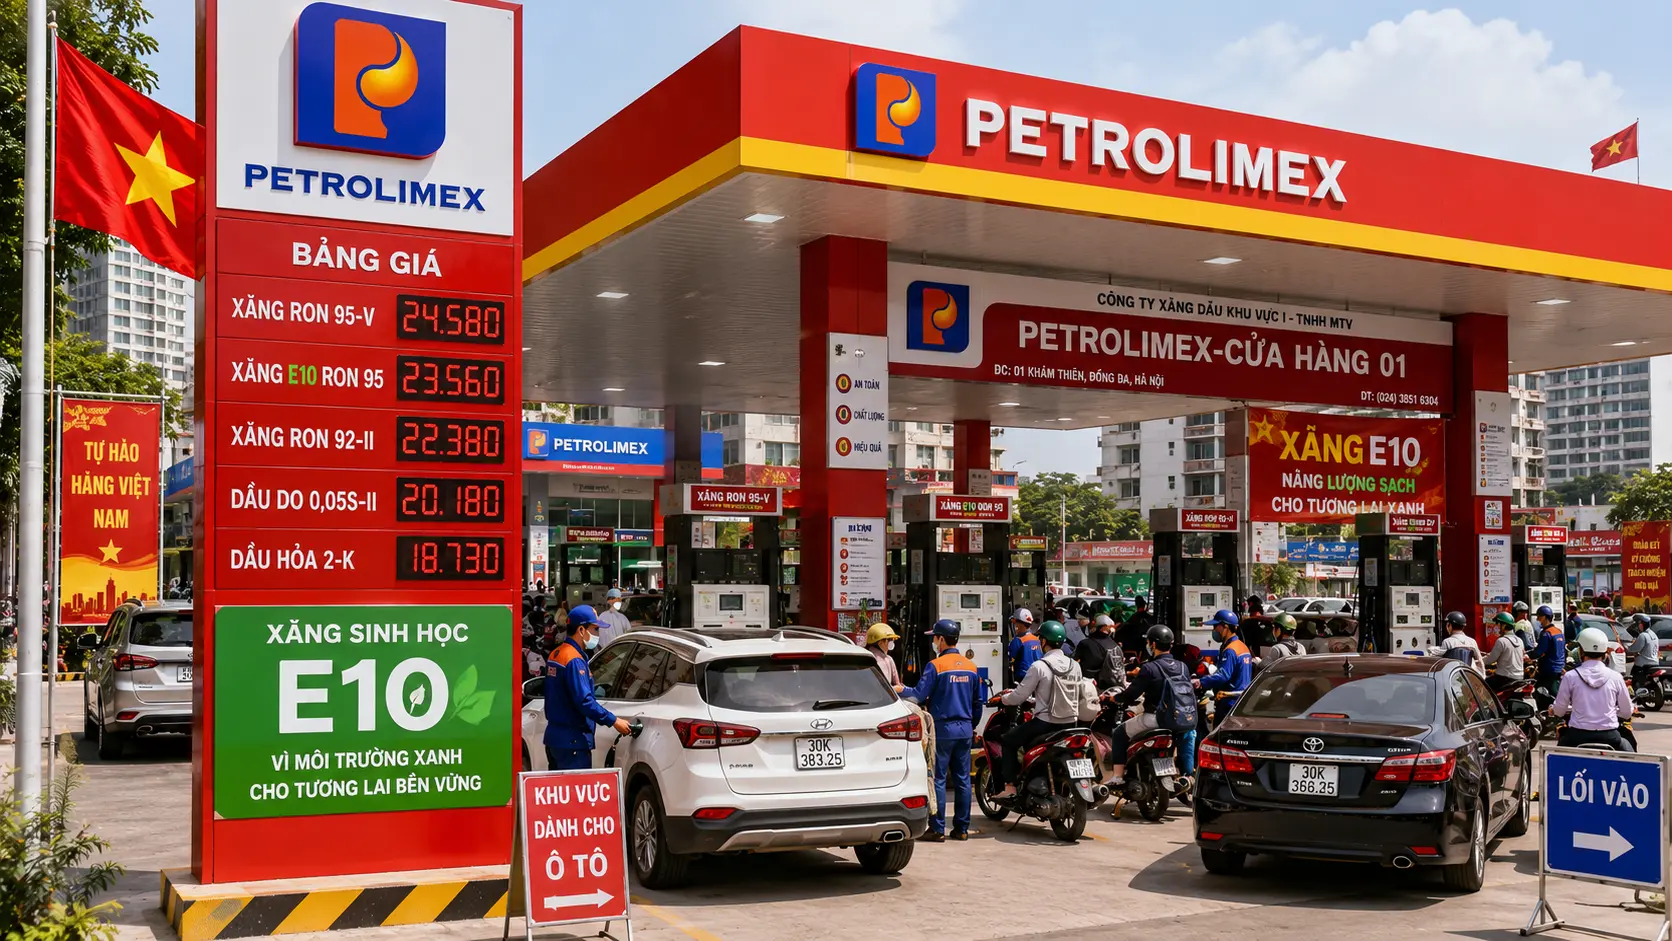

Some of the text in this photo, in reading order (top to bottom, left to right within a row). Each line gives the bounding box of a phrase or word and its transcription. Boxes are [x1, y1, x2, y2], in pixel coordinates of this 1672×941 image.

[965, 97, 1348, 203] PETROLIMEX
[245, 163, 486, 212] PETROLIMEX
[292, 236, 442, 278] BẢNG GIÁ
[231, 293, 376, 327] XĂNG RON 95-V
[403, 301, 500, 338] 24.580
[1138, 297, 1155, 310] TY
[1226, 305, 1252, 319] KHU
[1255, 307, 1279, 324] VỰC
[1296, 313, 1327, 327] TNHH
[1330, 317, 1353, 330] MTV
[1019, 319, 1406, 378] PETROLIMEX-CỬA HÀNG 01
[231, 357, 384, 389] XĂNG E10 RON 95
[403, 362, 500, 398] 23.560
[994, 364, 1011, 376] ĐC:
[1014, 365, 1024, 377] 01
[1376, 391, 1397, 405] (024)
[1419, 395, 1439, 406] 6304
[231, 421, 374, 450] XĂNG RON 92-II
[402, 422, 500, 457] 22.380
[553, 438, 649, 455] PETROLIMEX
[84, 440, 105, 465] TỰ
[1369, 435, 1421, 467] E10
[118, 472, 151, 500] VIỆT
[230, 481, 377, 513] DẦU DO 0,05S-II
[726, 491, 746, 502] RON
[1327, 473, 1376, 495] LƯỢNG
[1379, 477, 1416, 496] SẠCH
[402, 483, 500, 517] 20.180
[1271, 496, 1425, 515] CHO TƯƠNG LAI XANH
[93, 508, 129, 529] NAM
[230, 541, 356, 570] DẦU HỎA 2-K
[413, 542, 499, 574] 18.730
[266, 619, 469, 648] XĂNG SINH HỌC
[279, 657, 449, 734] E10
[271, 746, 463, 771] VÌ MÔI TRƯỜNG XANH
[807, 739, 831, 752] 30K
[801, 753, 842, 768] 383.25
[1302, 766, 1326, 780] 30K
[249, 771, 482, 800] CHO TƯƠNG LAI BỀN VỪNG
[534, 781, 611, 807] KHU VỰC
[1558, 768, 1650, 809] LỐI VÀO
[534, 814, 615, 840] DÀNH CHO
[545, 847, 608, 881] Ô TÔ
